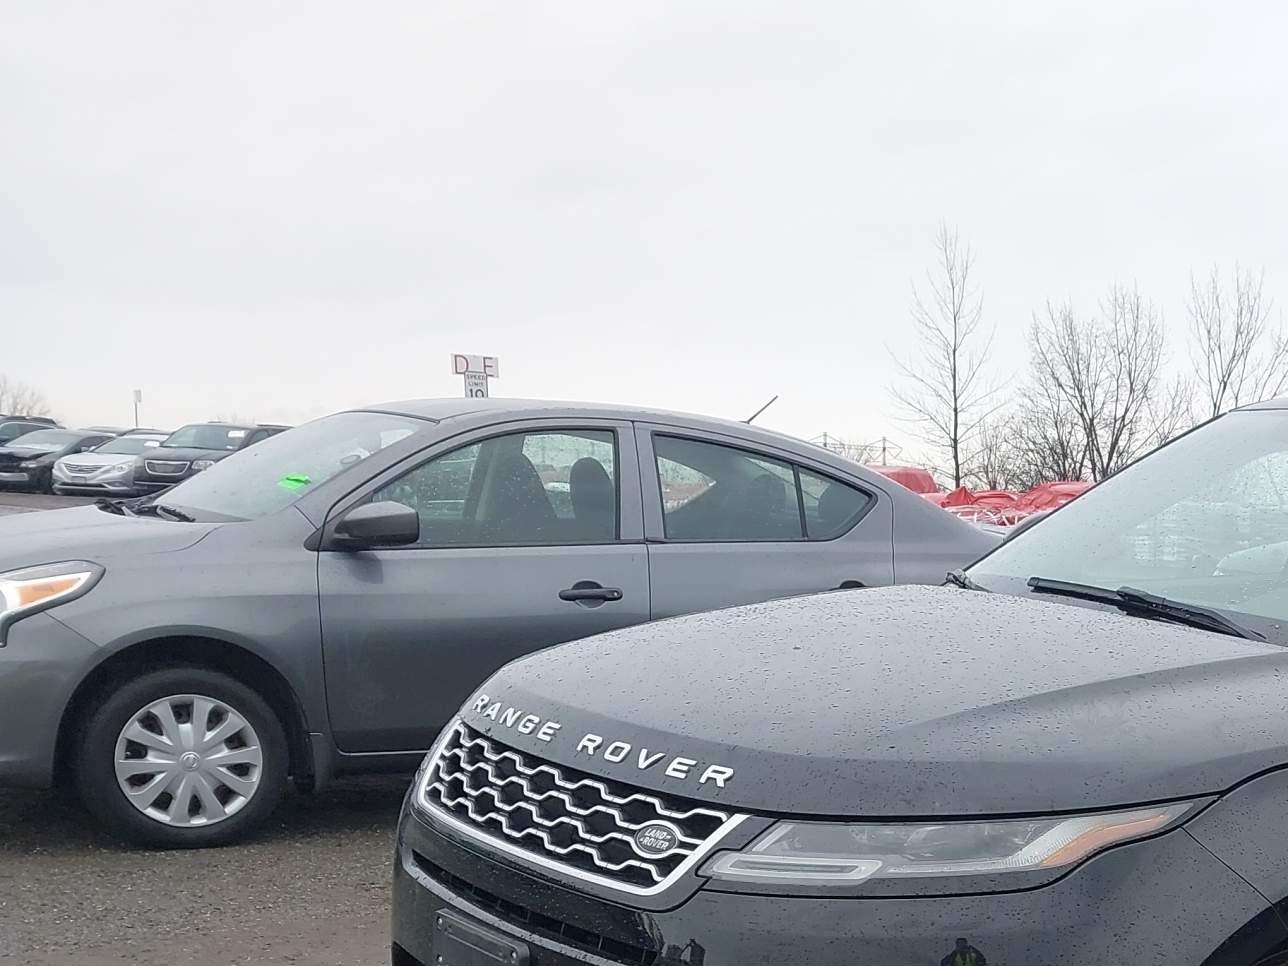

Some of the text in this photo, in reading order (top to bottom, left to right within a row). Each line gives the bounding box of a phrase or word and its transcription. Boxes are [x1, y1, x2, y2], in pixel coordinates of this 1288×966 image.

[454, 354, 494, 377] D E
[471, 694, 735, 788] RANGE ROVER
